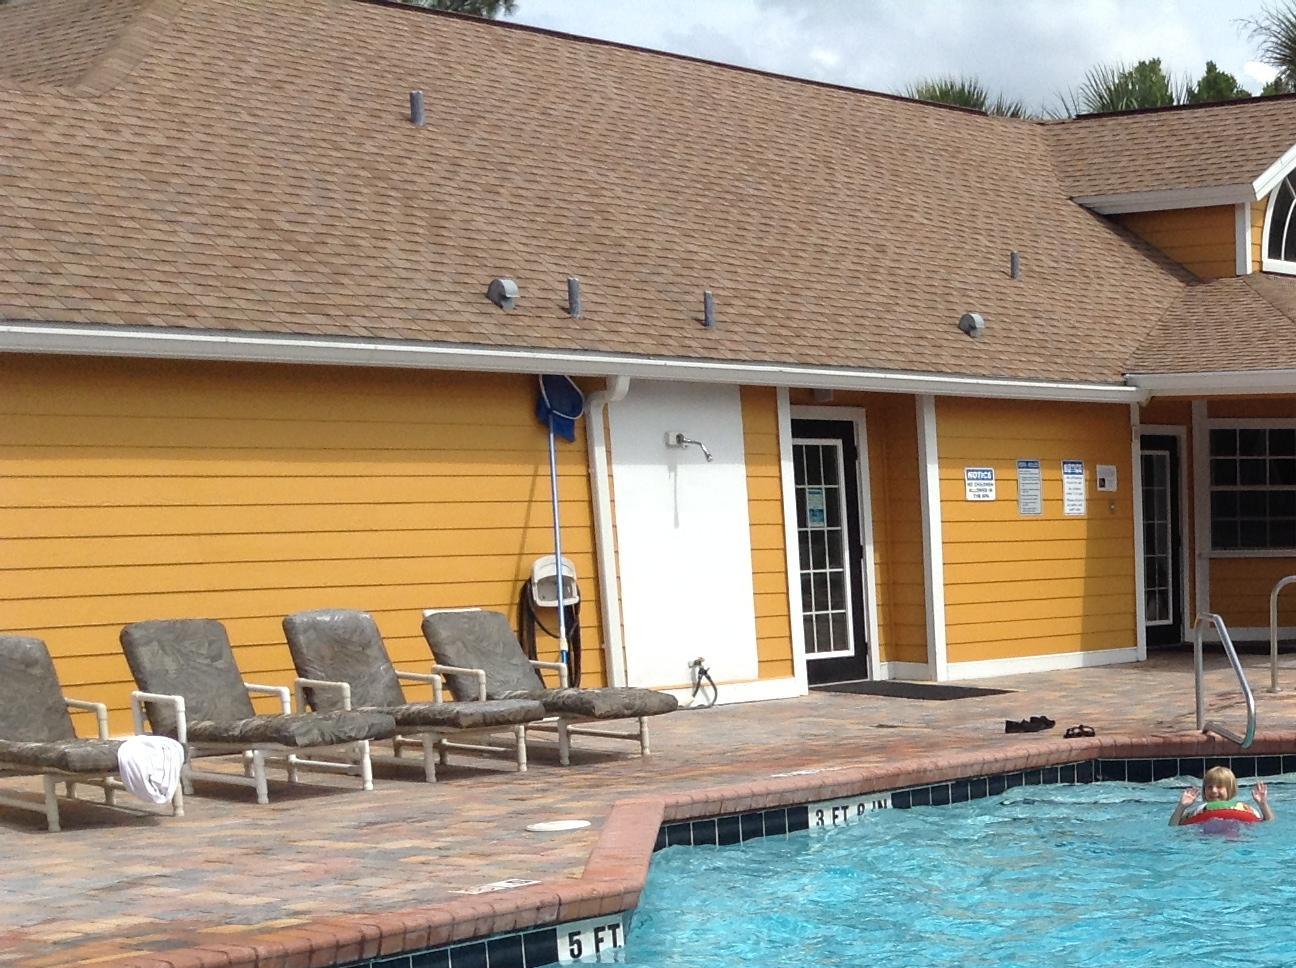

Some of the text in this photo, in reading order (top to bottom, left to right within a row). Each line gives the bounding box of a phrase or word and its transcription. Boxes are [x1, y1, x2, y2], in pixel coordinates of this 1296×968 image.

[967, 471, 993, 480] NOTICE
[815, 809, 825, 827] 3
[832, 804, 850, 827] FT
[568, 930, 583, 959] 5
